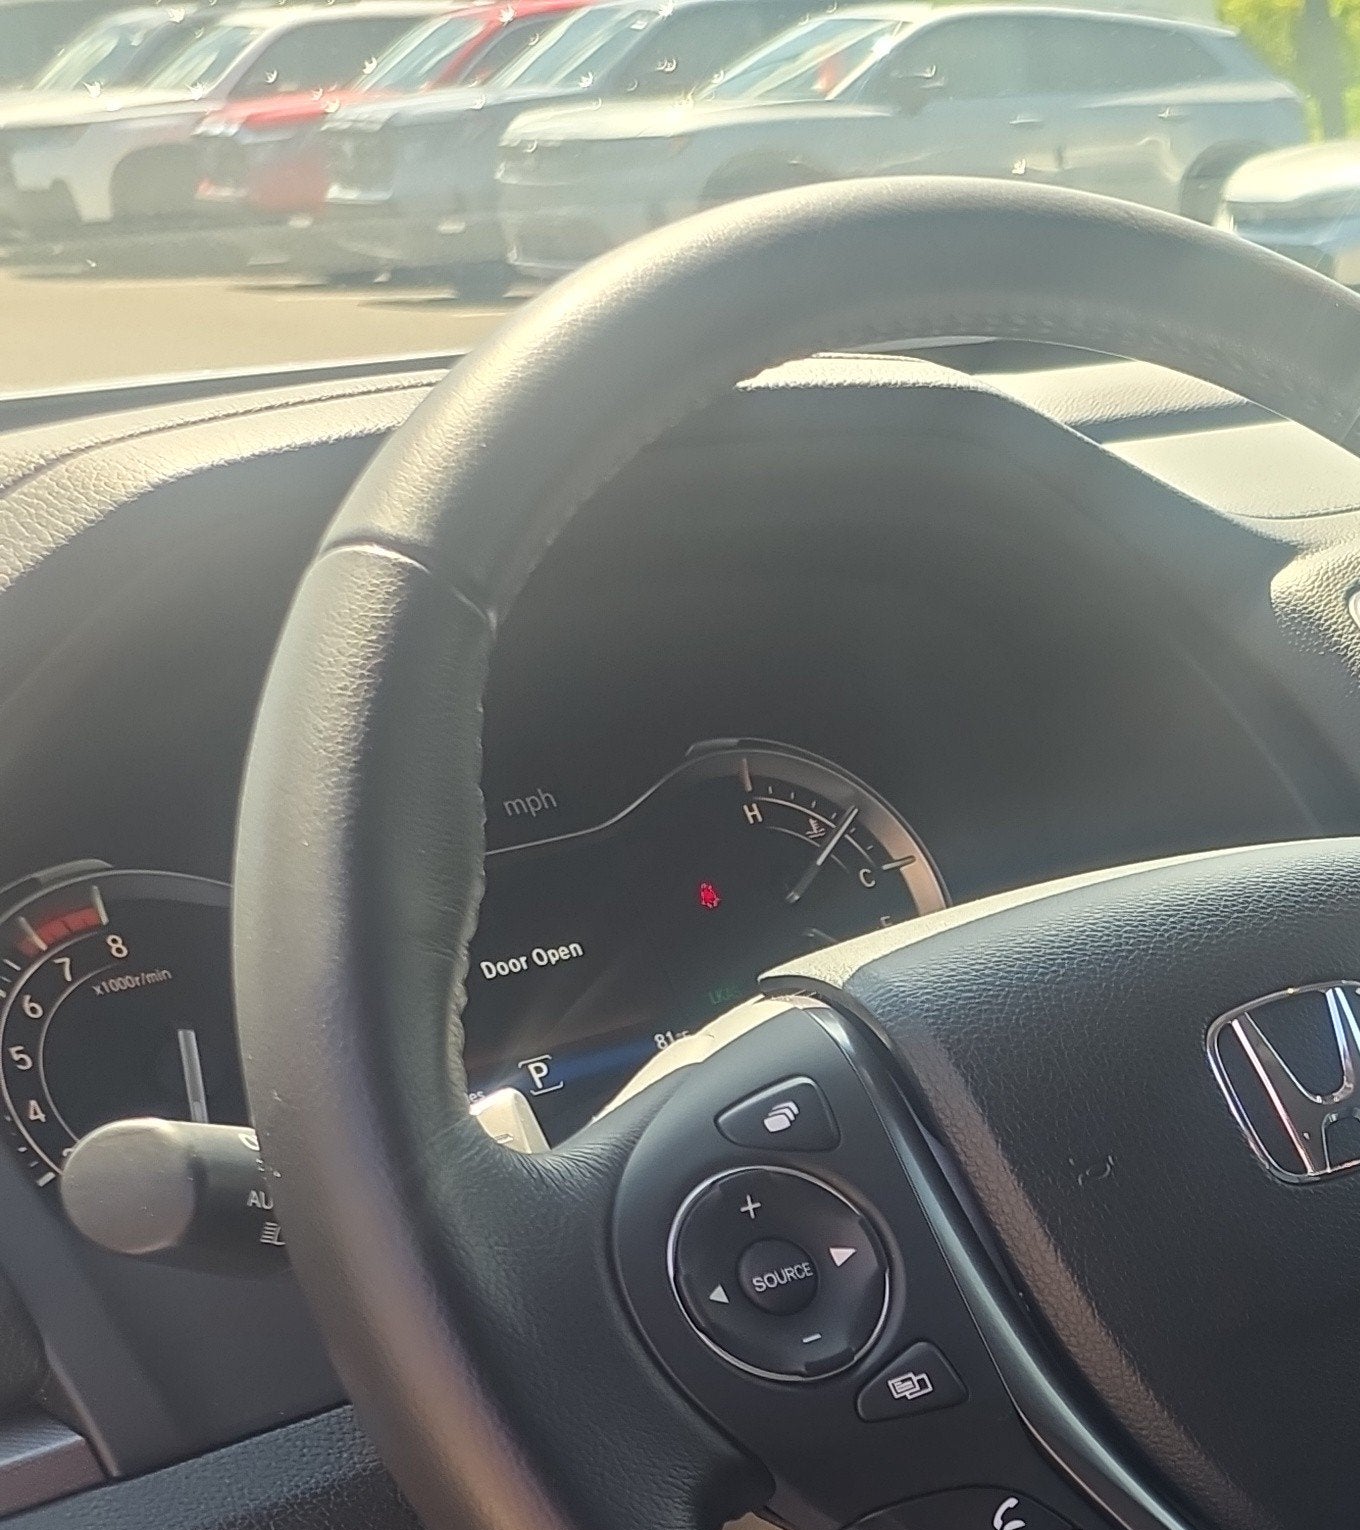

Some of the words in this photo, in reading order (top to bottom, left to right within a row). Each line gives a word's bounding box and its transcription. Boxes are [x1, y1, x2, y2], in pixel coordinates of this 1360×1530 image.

[503, 789, 557, 818] mph
[743, 804, 764, 824] H
[859, 868, 876, 888] C
[106, 934, 128, 958] 8
[54, 957, 74, 982] 7
[480, 954, 528, 981] Door
[531, 938, 585, 968] Open
[92, 967, 173, 996] x1000r/min
[22, 994, 43, 1019] 6
[8, 1045, 33, 1071] 5
[527, 1061, 549, 1089] P
[28, 1100, 46, 1124] 4
[246, 1190, 274, 1210] AU
[752, 1261, 814, 1293] SOURCE
